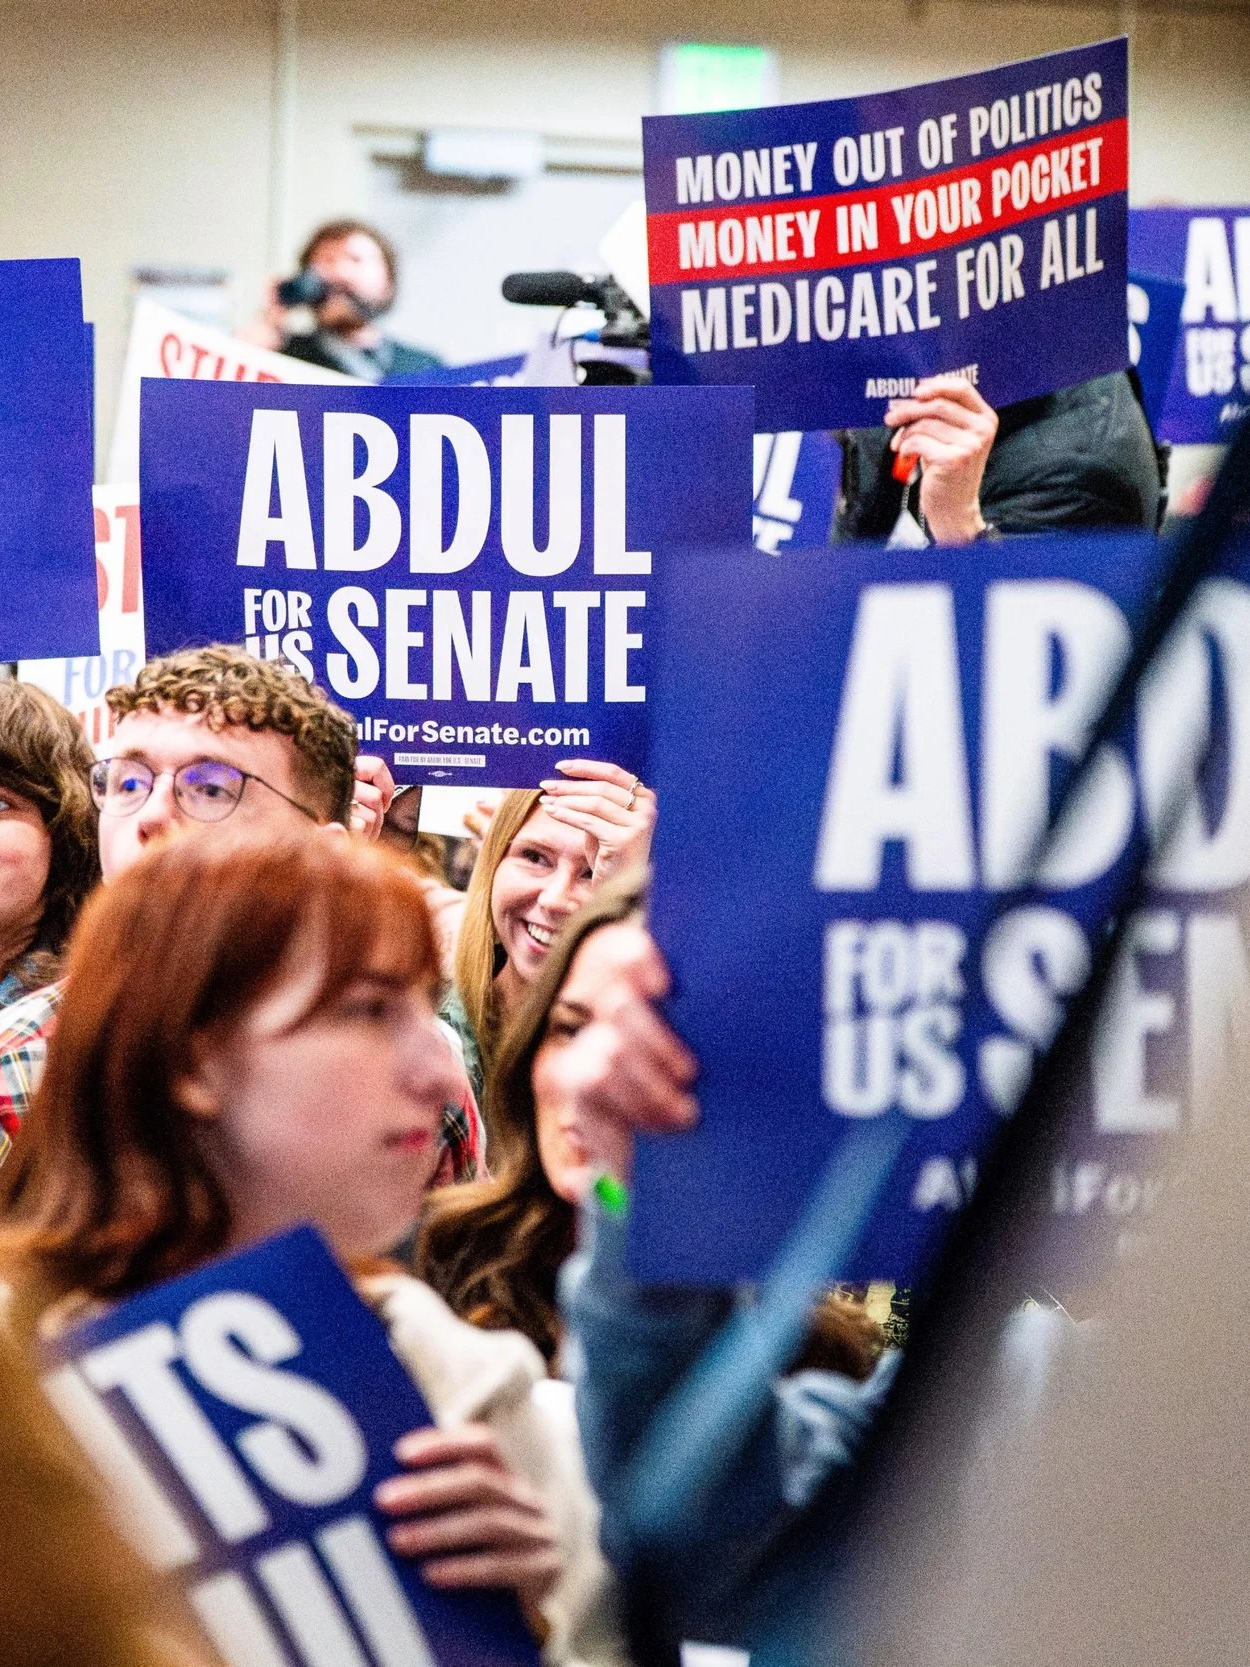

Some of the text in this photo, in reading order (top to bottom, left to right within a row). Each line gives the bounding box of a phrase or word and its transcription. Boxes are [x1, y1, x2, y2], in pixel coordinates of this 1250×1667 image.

[676, 73, 1102, 205] MONEY OUT OF POLITICS
[679, 138, 1103, 270] MONEY IN YOUR POCKET
[681, 260, 941, 355] MEDICARE
[956, 235, 1025, 320] FOR
[1041, 208, 1104, 290] ALL
[236, 408, 652, 577] ABDUL
[64, 649, 138, 706] FOR
[244, 585, 647, 704] FOR SENATE
[823, 920, 967, 1006] FOR
[823, 1006, 967, 1118] US
